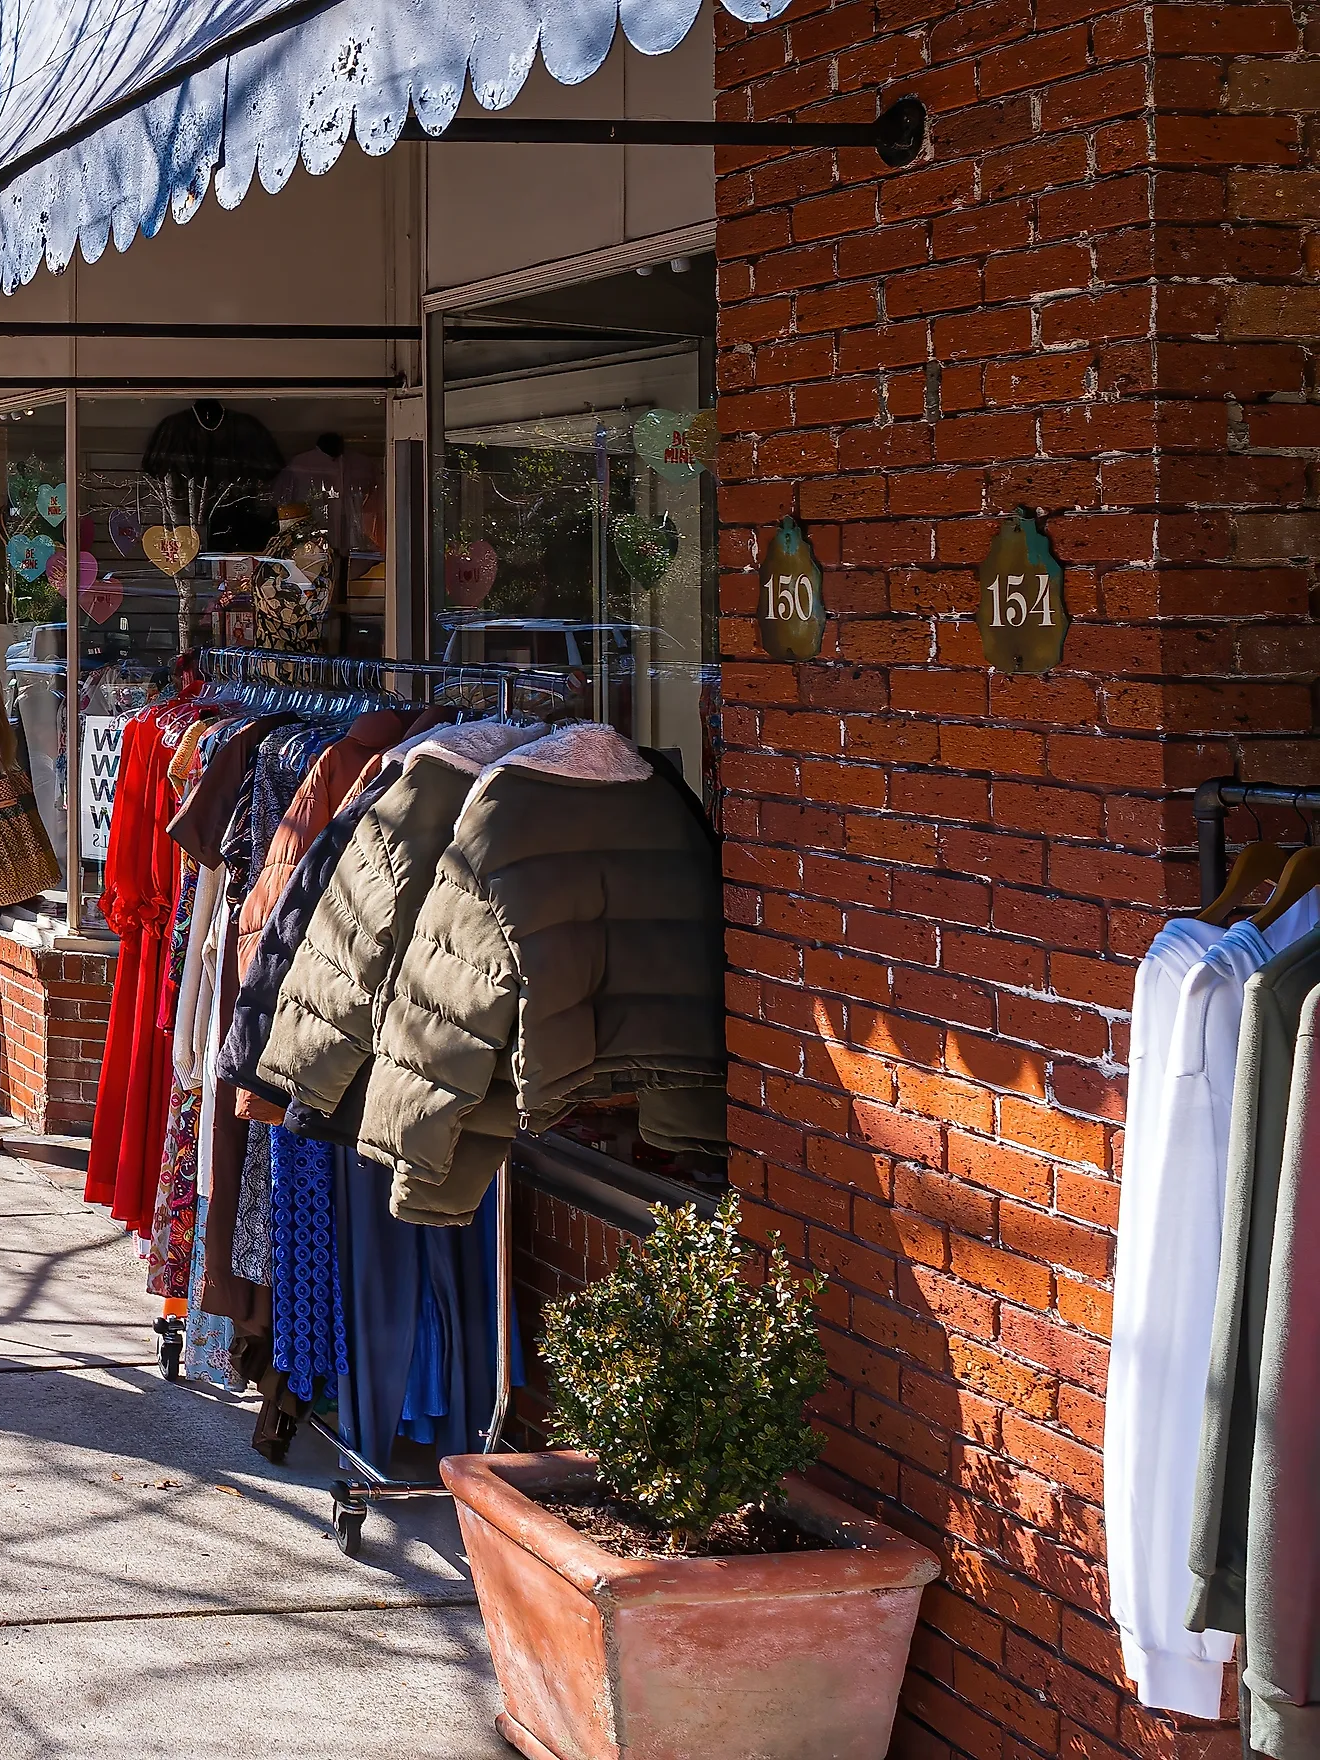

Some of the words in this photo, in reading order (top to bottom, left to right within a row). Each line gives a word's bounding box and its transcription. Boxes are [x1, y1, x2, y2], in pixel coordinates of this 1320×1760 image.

[672, 431, 689, 447] BE
[664, 448, 695, 464] MINE
[50, 496, 58, 505] BE
[160, 540, 180, 551] KISS
[24, 549, 35, 559] BE
[764, 573, 814, 621] 150
[987, 572, 1056, 628] 154
